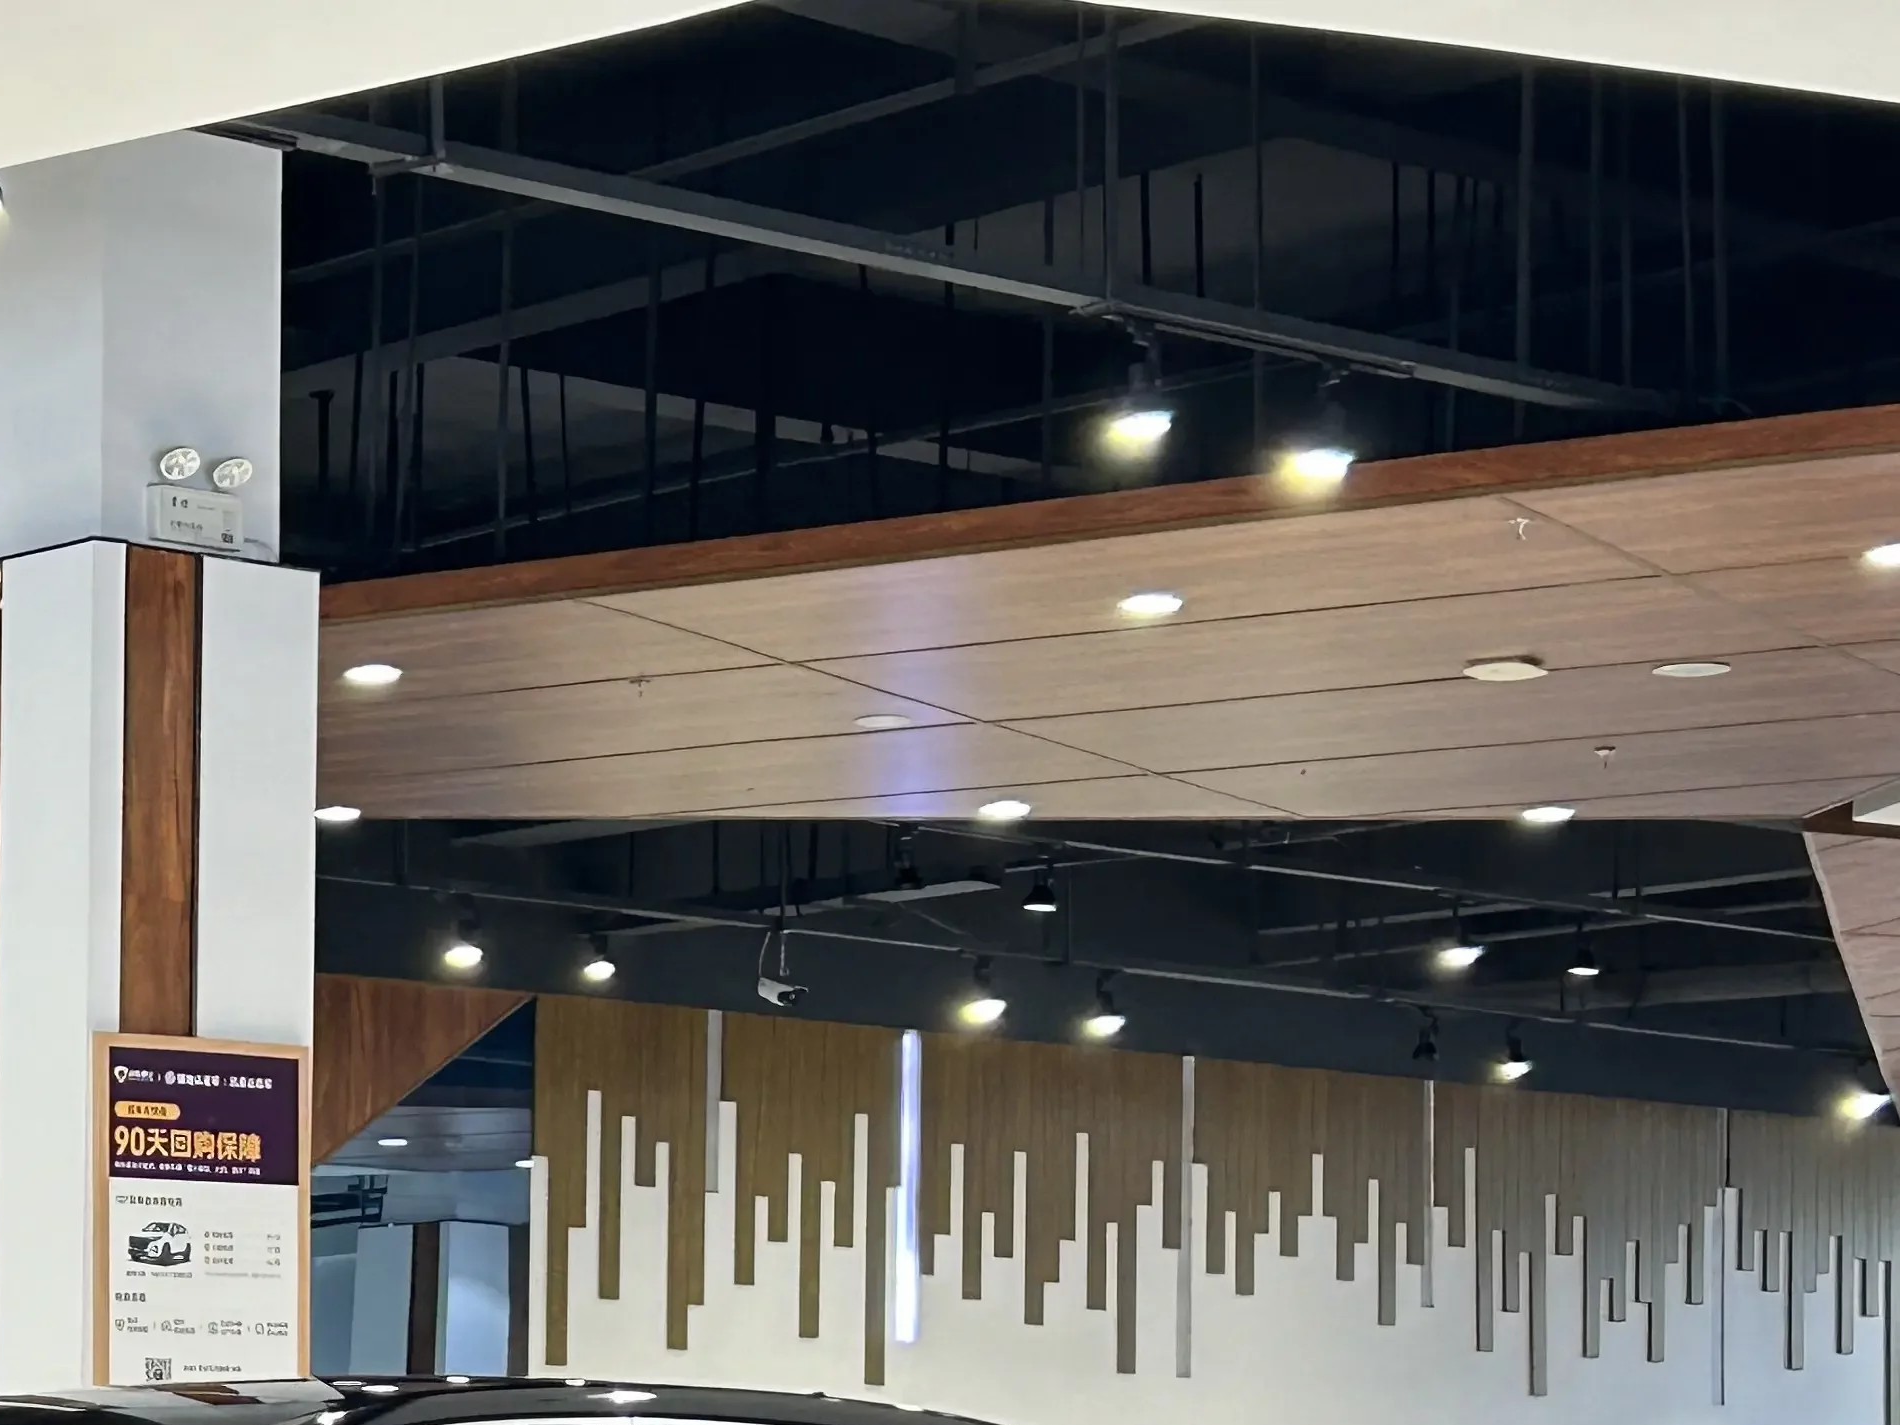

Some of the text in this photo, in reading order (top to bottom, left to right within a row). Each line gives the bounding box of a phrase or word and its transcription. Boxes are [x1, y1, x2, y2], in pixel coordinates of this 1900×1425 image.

[114, 1125, 262, 1162] 90天回购保障
